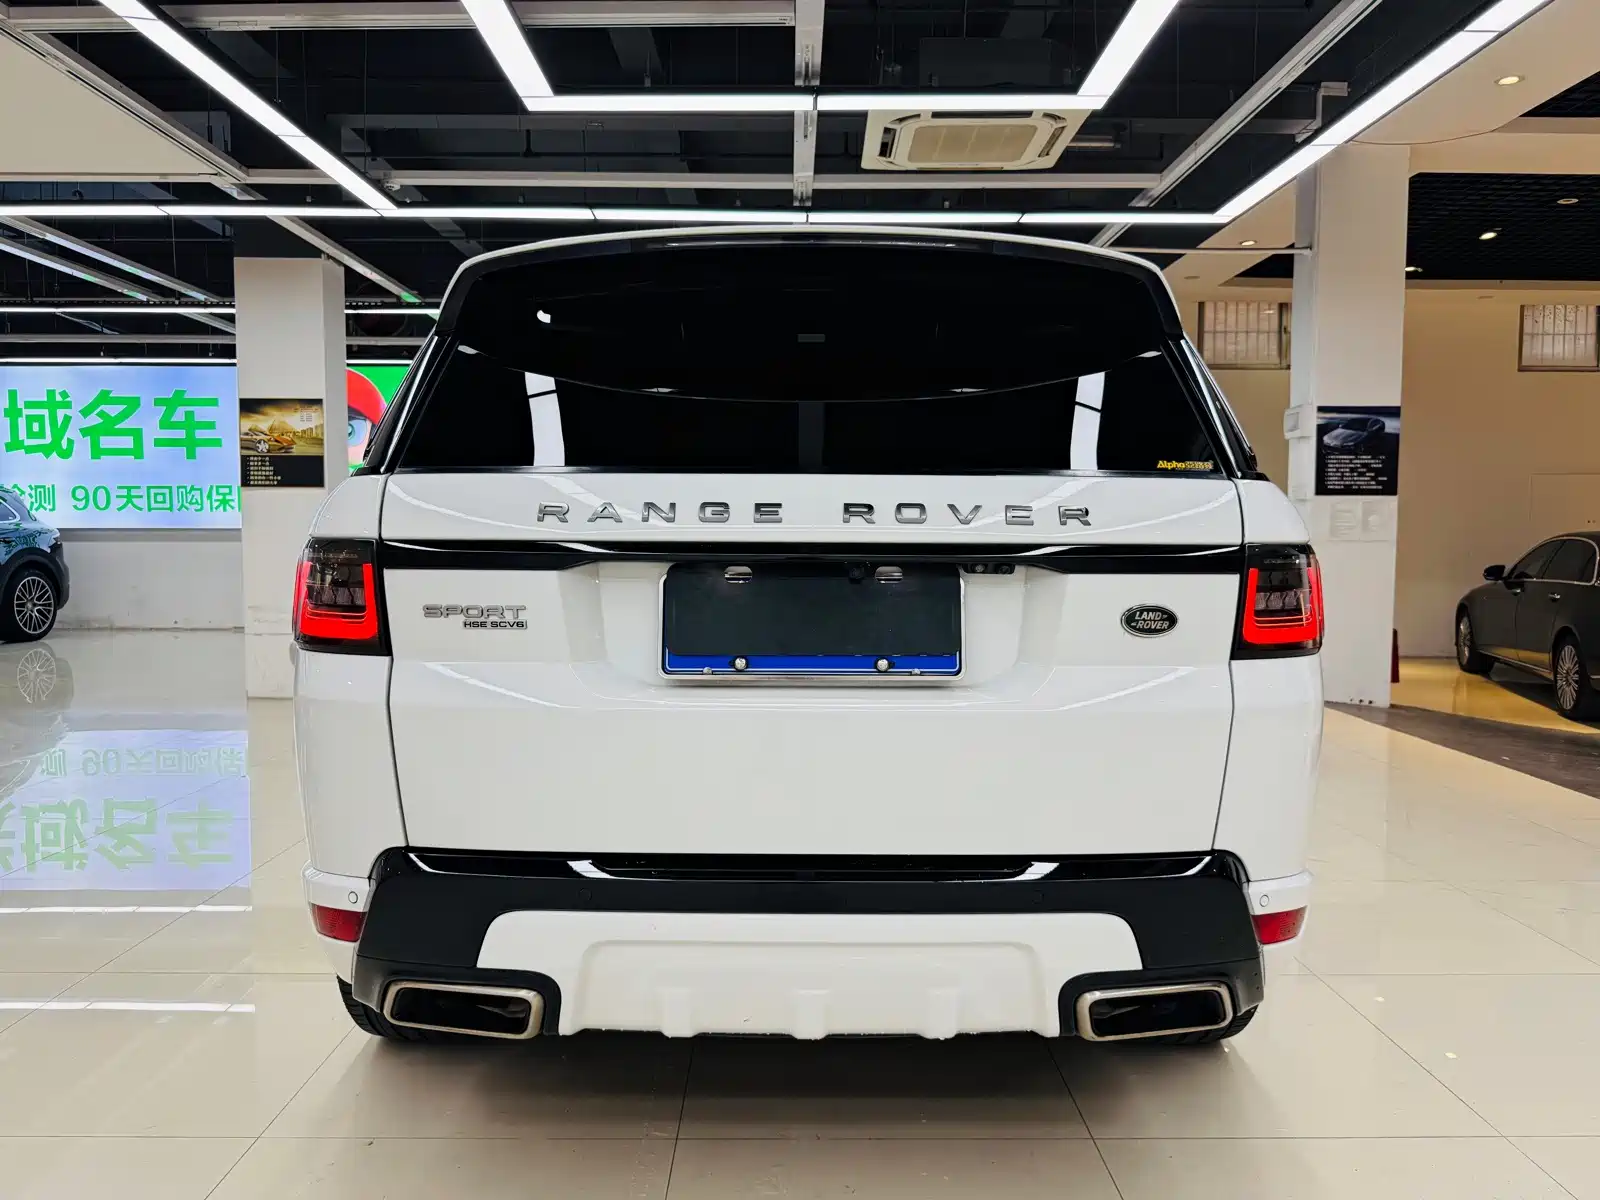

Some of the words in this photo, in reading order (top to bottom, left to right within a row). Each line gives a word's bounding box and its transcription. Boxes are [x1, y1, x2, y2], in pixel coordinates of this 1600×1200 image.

[4, 388, 223, 460] 域名车
[71, 484, 242, 512] 90天回购保
[537, 501, 783, 523] RANGE
[843, 502, 1092, 526] ROVER
[422, 603, 527, 619] SPORT
[1134, 611, 1162, 620] LAND
[1136, 620, 1169, 629] ROVER
